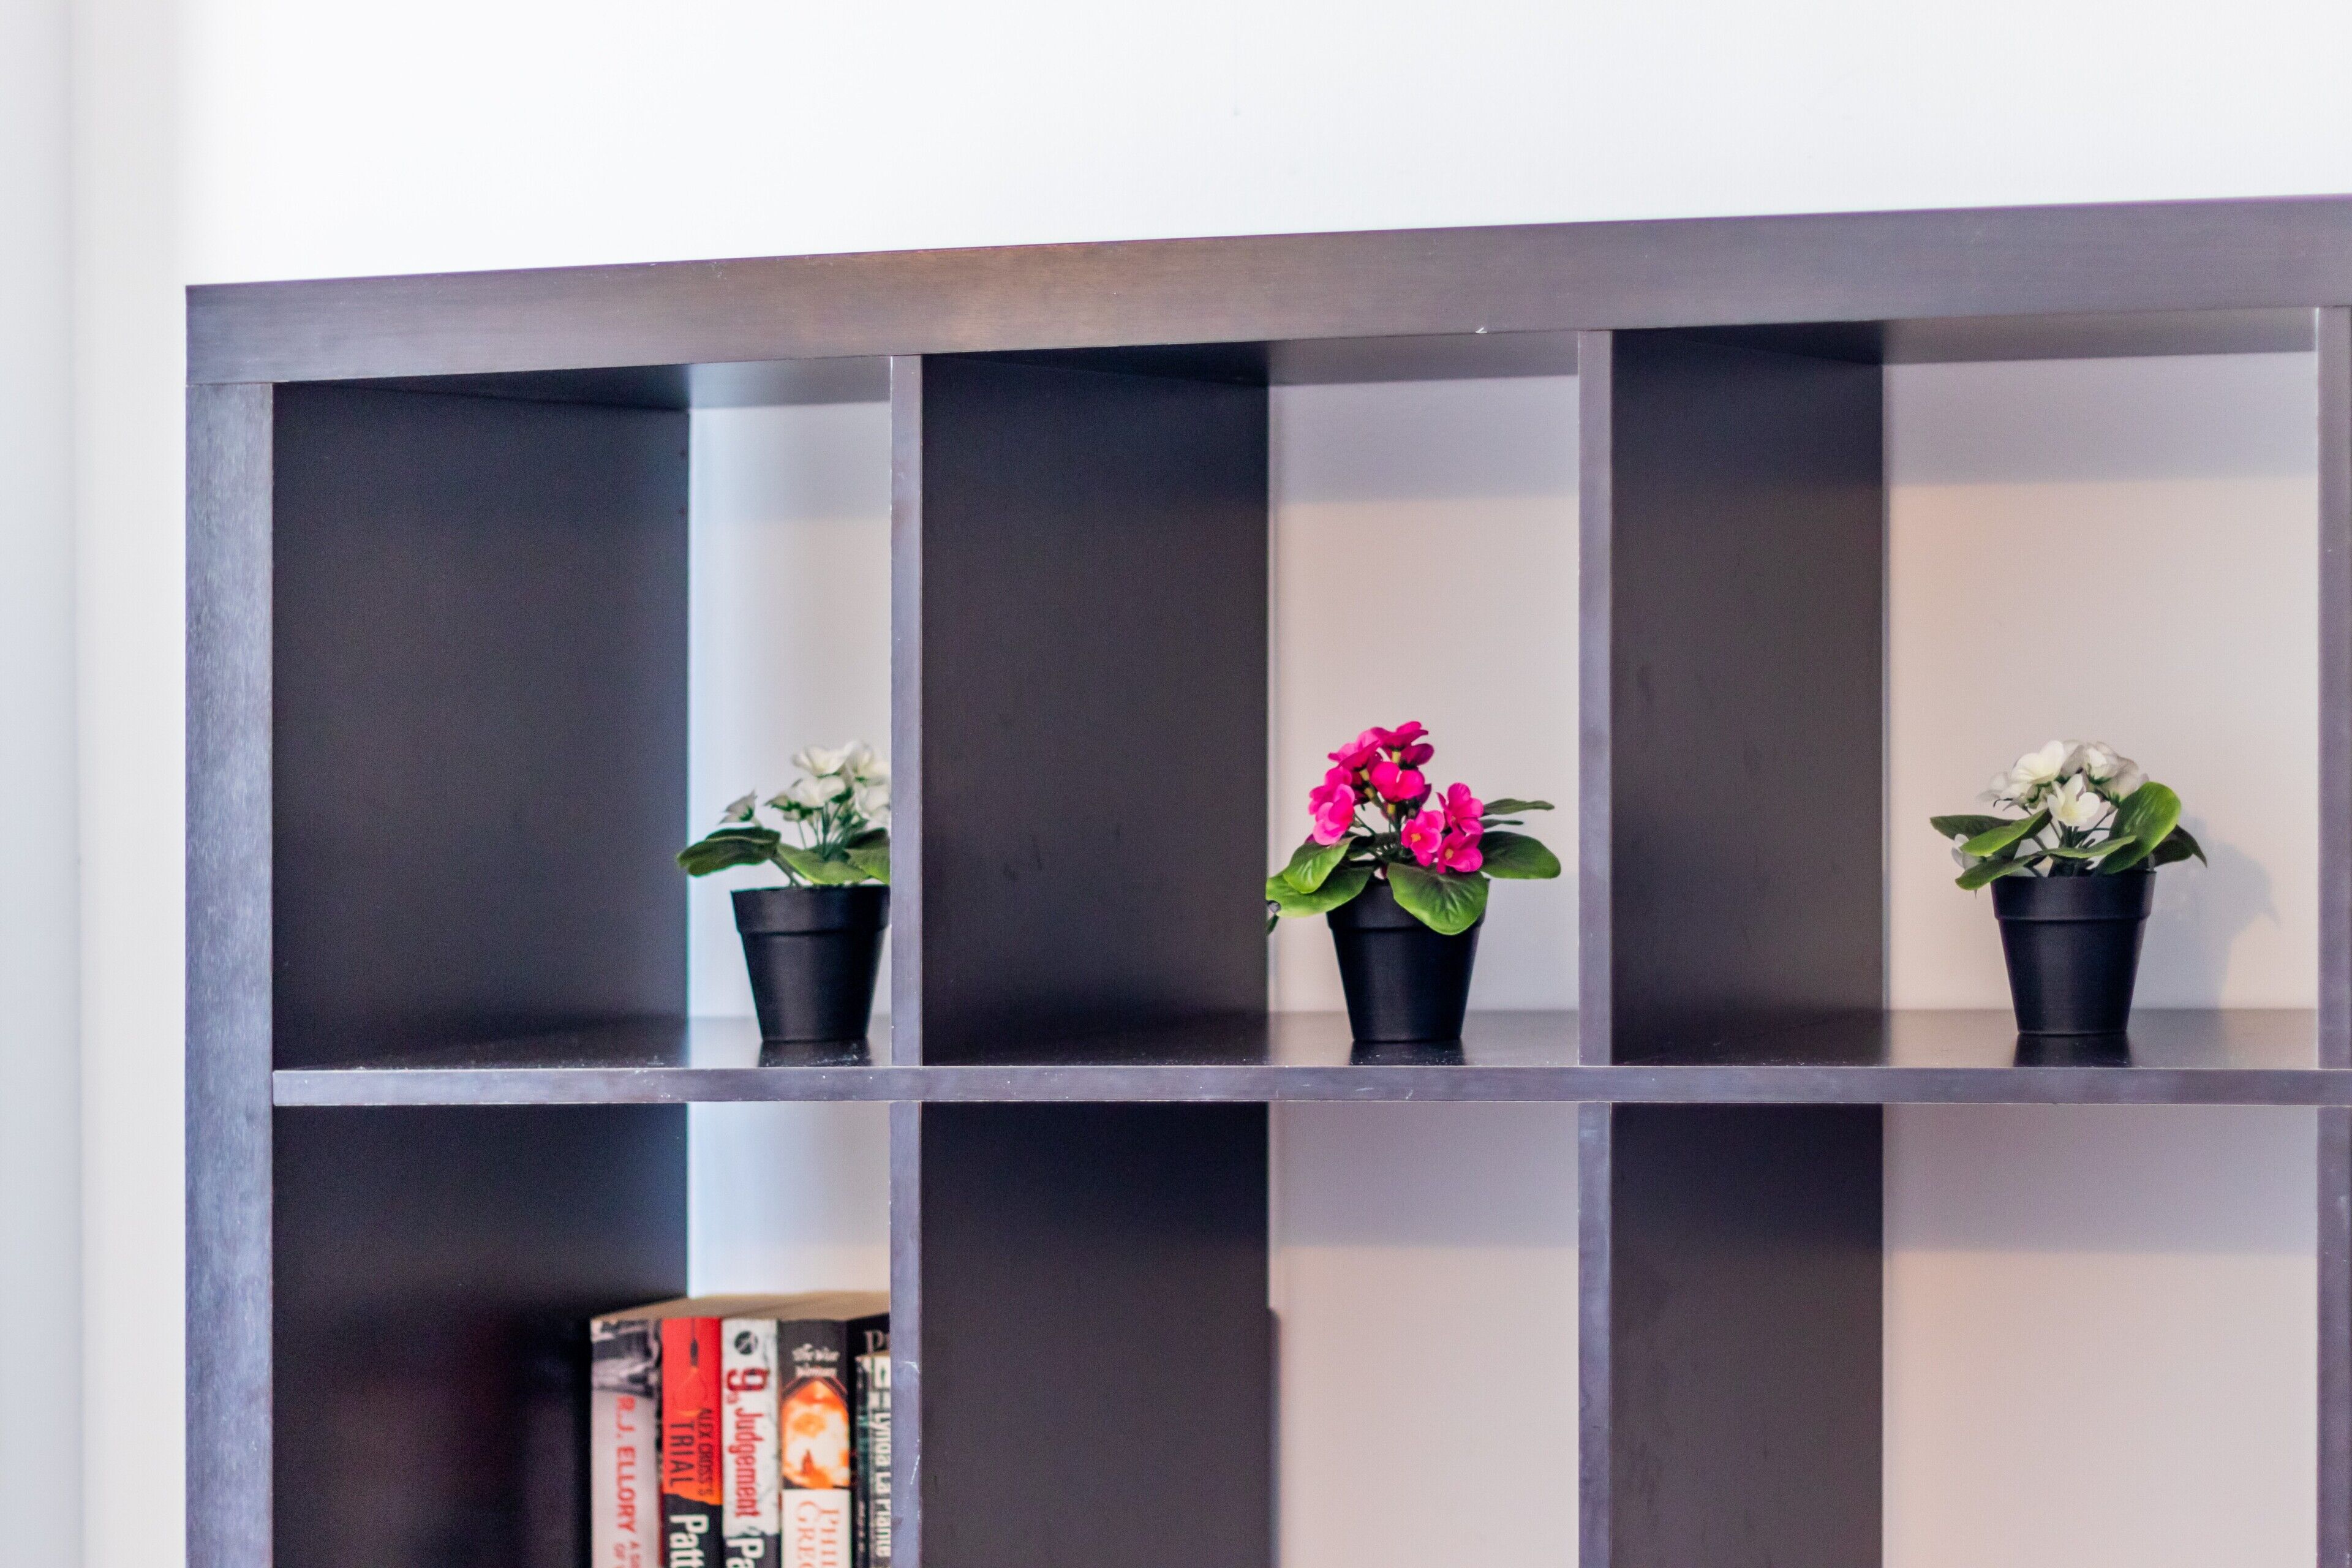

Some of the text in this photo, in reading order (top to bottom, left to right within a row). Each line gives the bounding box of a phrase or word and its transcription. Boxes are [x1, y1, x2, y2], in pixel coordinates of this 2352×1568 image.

[669, 1420, 695, 1488] TRIAL
[697, 1408, 713, 1438] ALEX
[617, 1446, 637, 1533] ELLORY
[728, 1408, 765, 1518] Judgement
